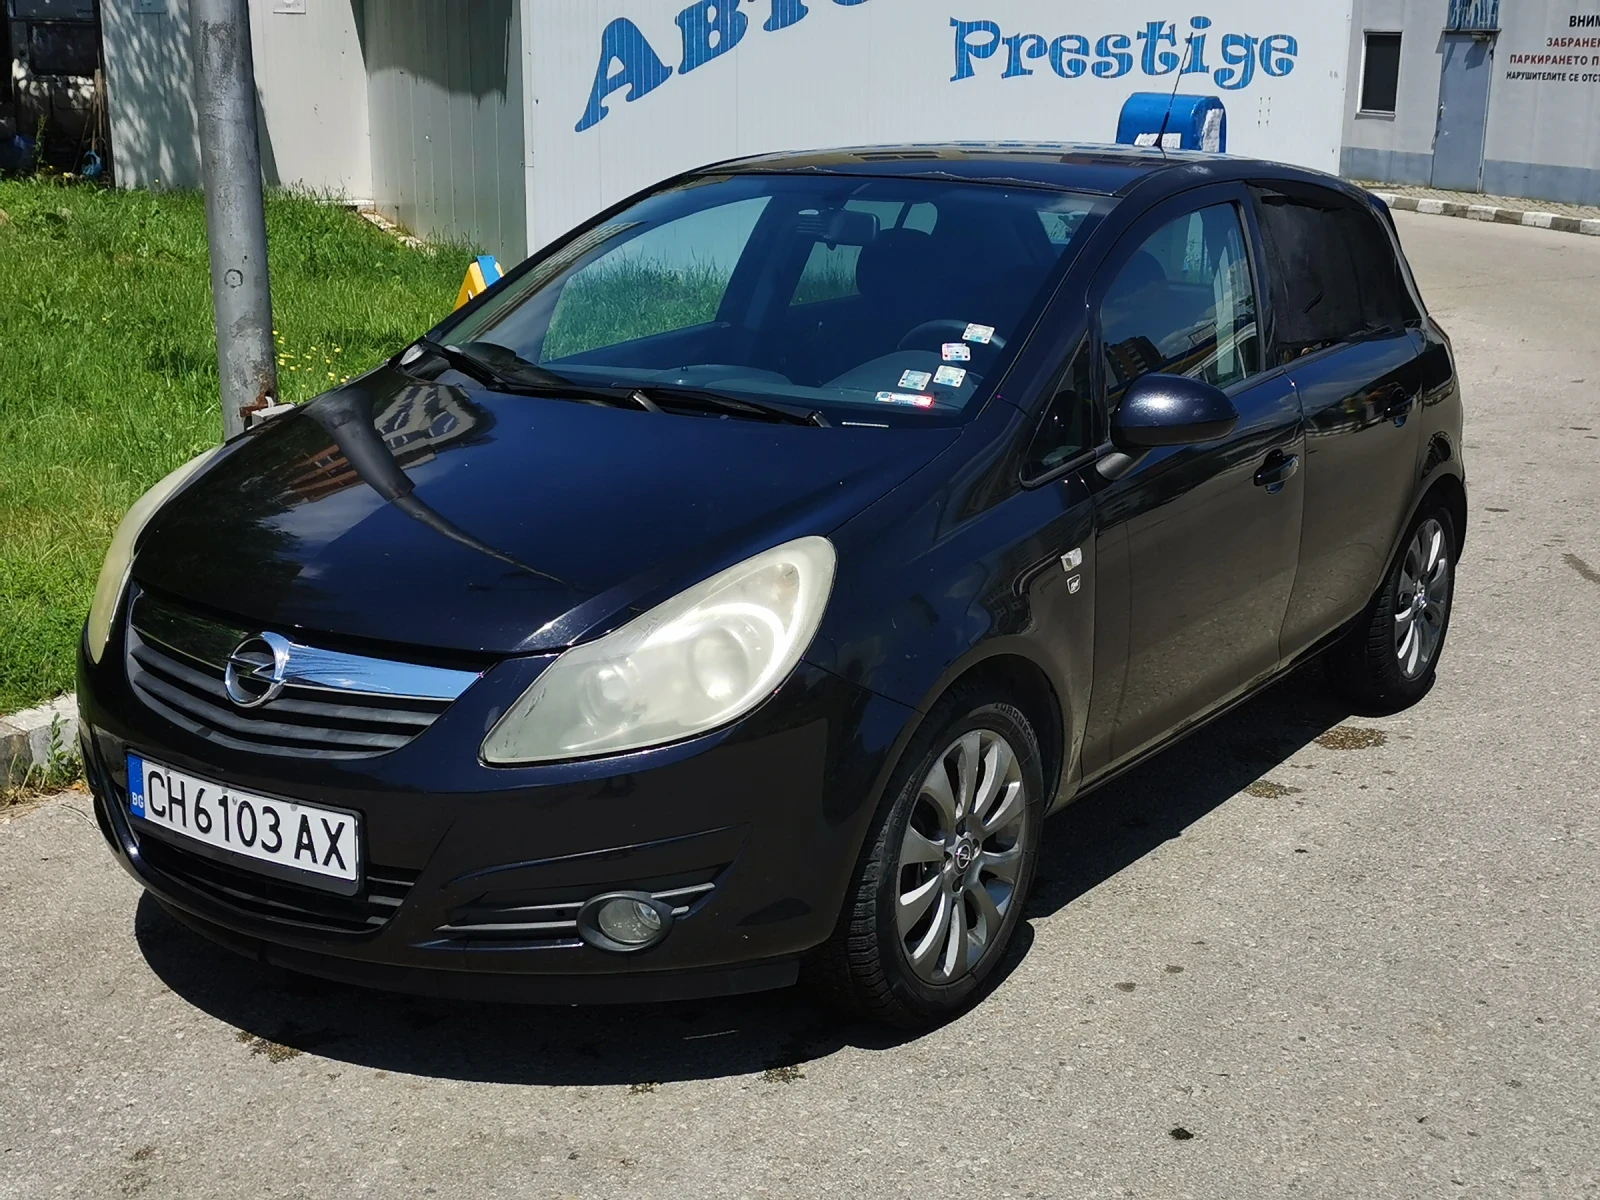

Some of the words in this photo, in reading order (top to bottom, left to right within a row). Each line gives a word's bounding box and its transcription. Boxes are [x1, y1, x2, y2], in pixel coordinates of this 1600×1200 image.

[949, 15, 1299, 90] Prestige
[1509, 54, 1588, 66] ПАРКИРАНЕТО
[574, 0, 868, 132] АВ
[1506, 71, 1566, 81] НАРУШИТЕЛИТЕ
[1569, 73, 1579, 82] СЕ
[132, 790, 144, 809] BG
